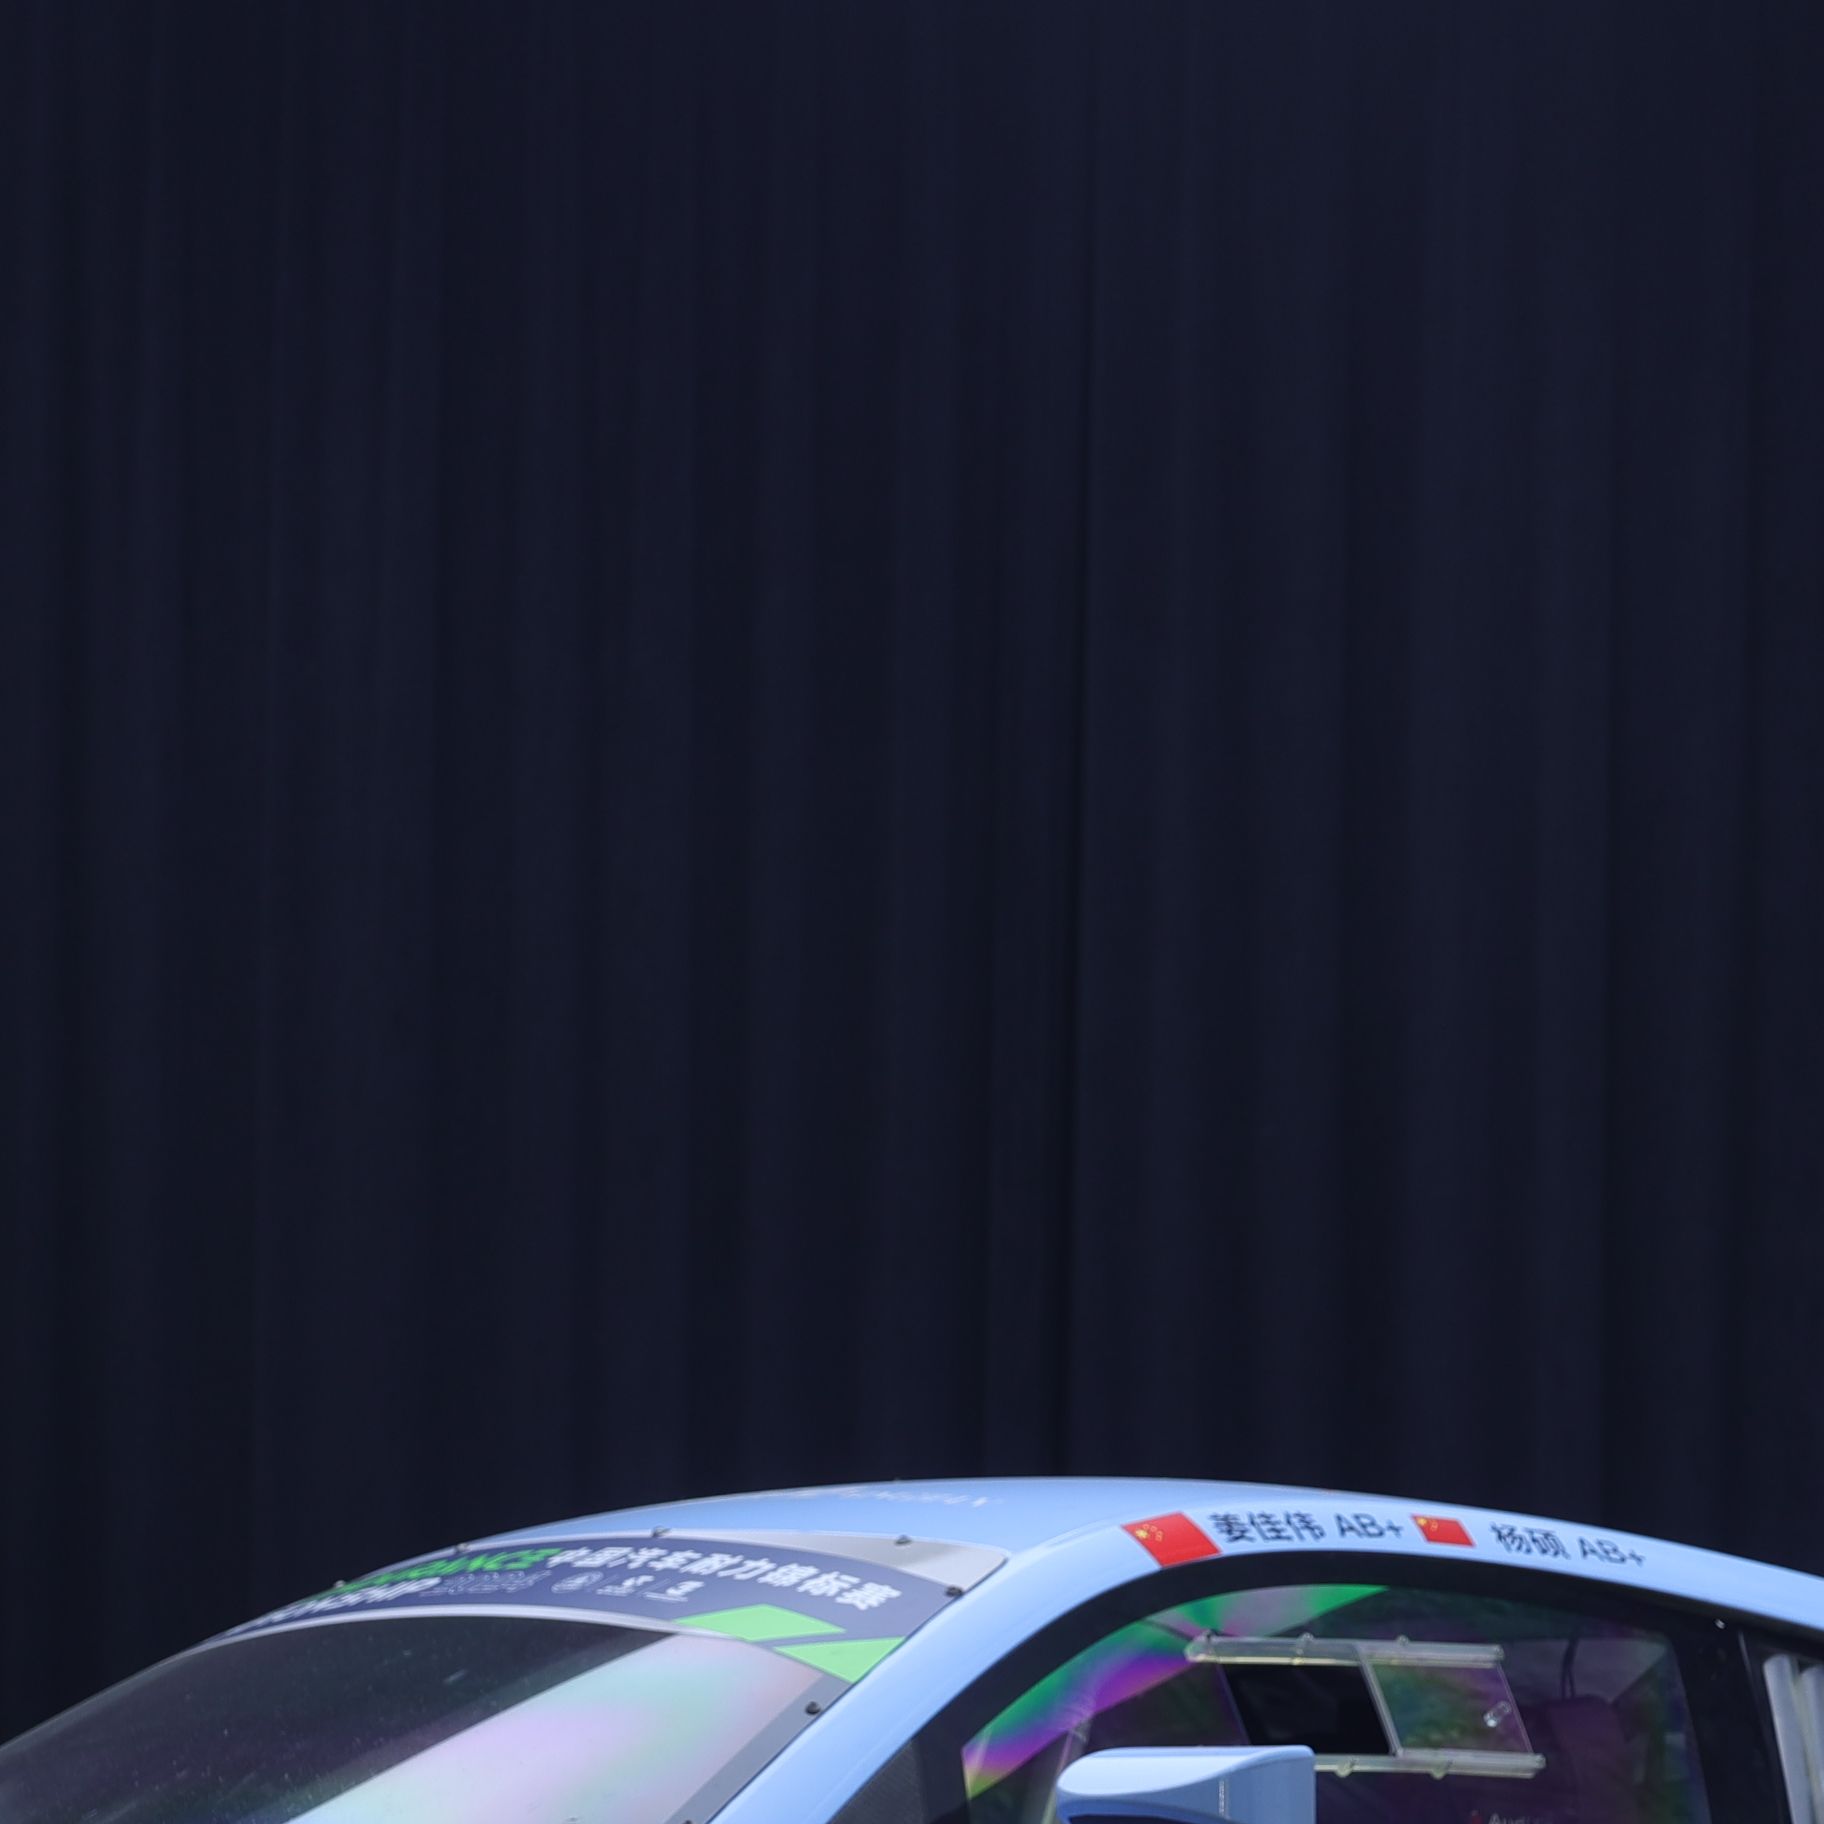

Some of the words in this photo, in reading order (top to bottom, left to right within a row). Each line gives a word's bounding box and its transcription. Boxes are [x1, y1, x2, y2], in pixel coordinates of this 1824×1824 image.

[1209, 1511, 1325, 1543] 姜佳伟
[1334, 1513, 1404, 1540] AB+
[1489, 1521, 1573, 1561] 杨硕
[1579, 1536, 1646, 1568] AB+
